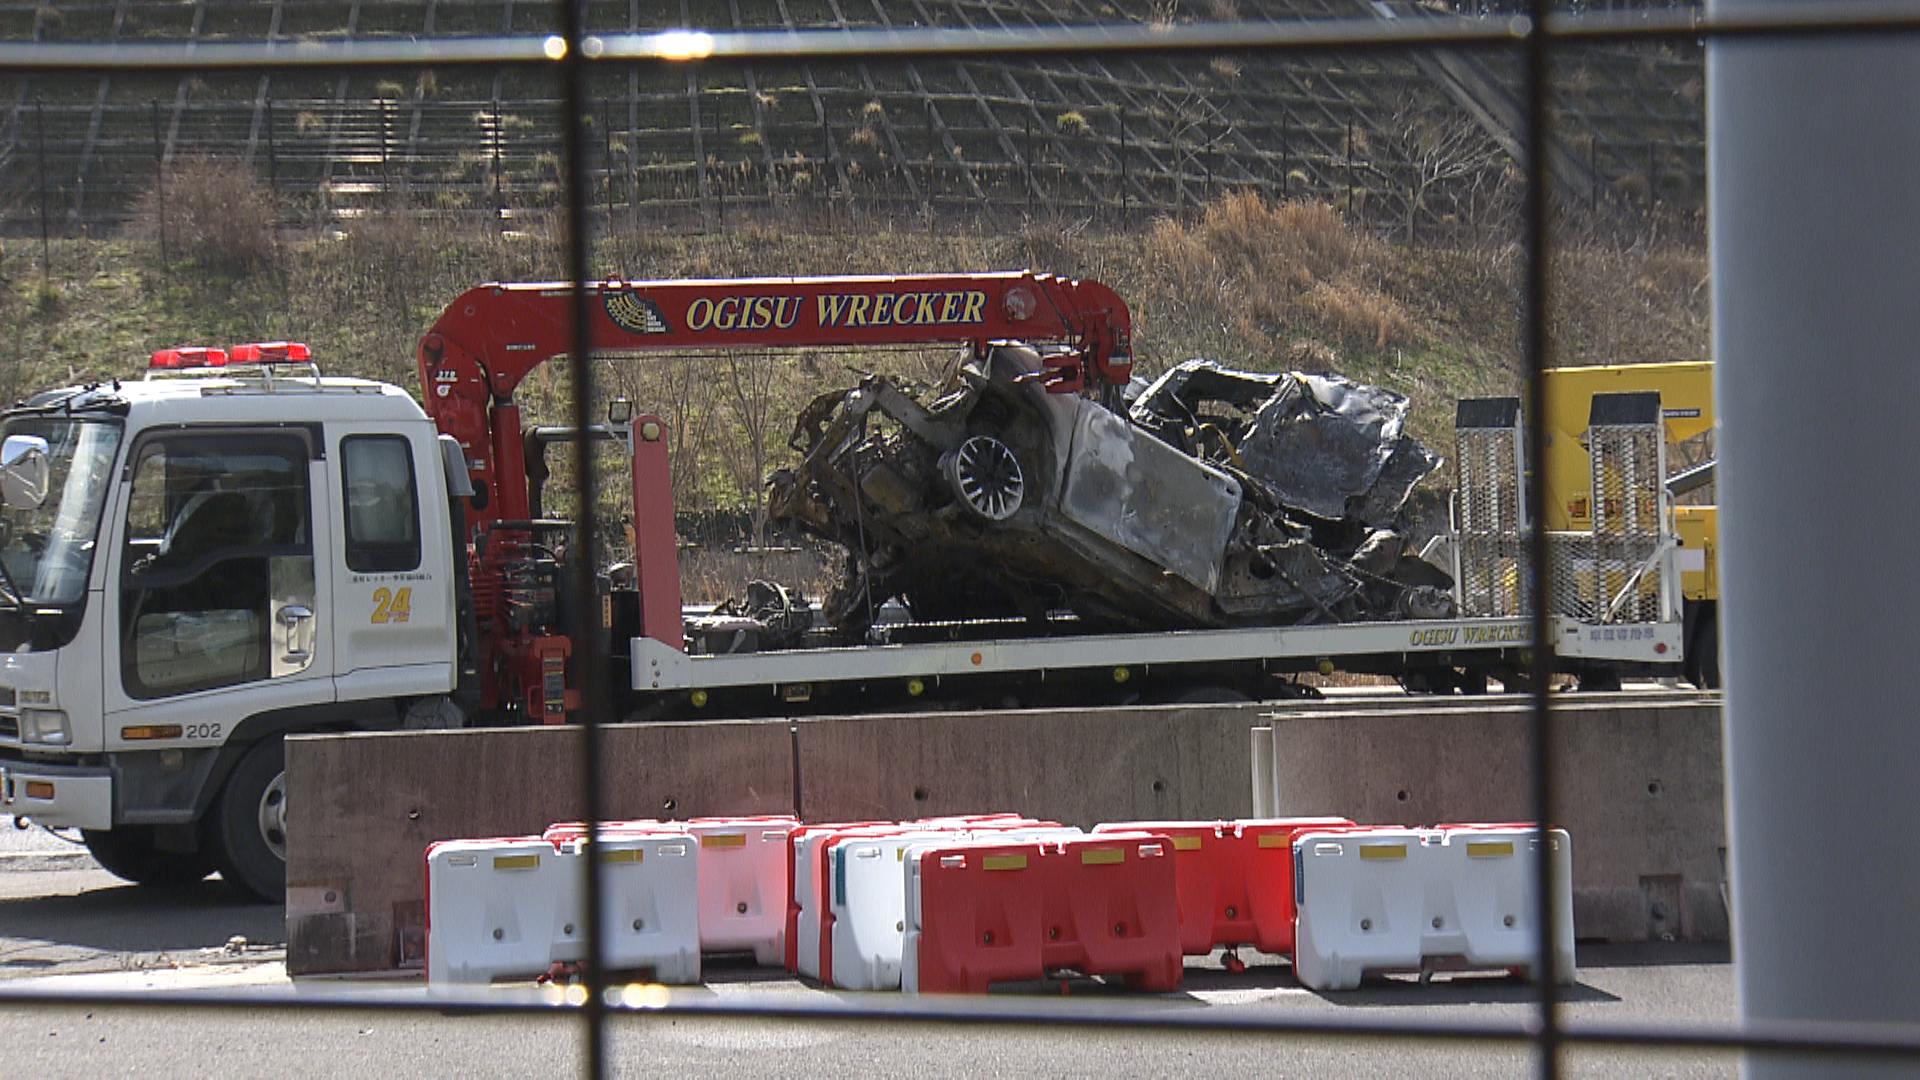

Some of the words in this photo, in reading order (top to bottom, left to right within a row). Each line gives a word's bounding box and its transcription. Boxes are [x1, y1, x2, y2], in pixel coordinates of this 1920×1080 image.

[686, 297, 802, 330] OGISU
[816, 291, 986, 327] WRECKER
[371, 586, 412, 624] 24
[1410, 627, 1459, 646] OGISU
[186, 723, 221, 738] 202
